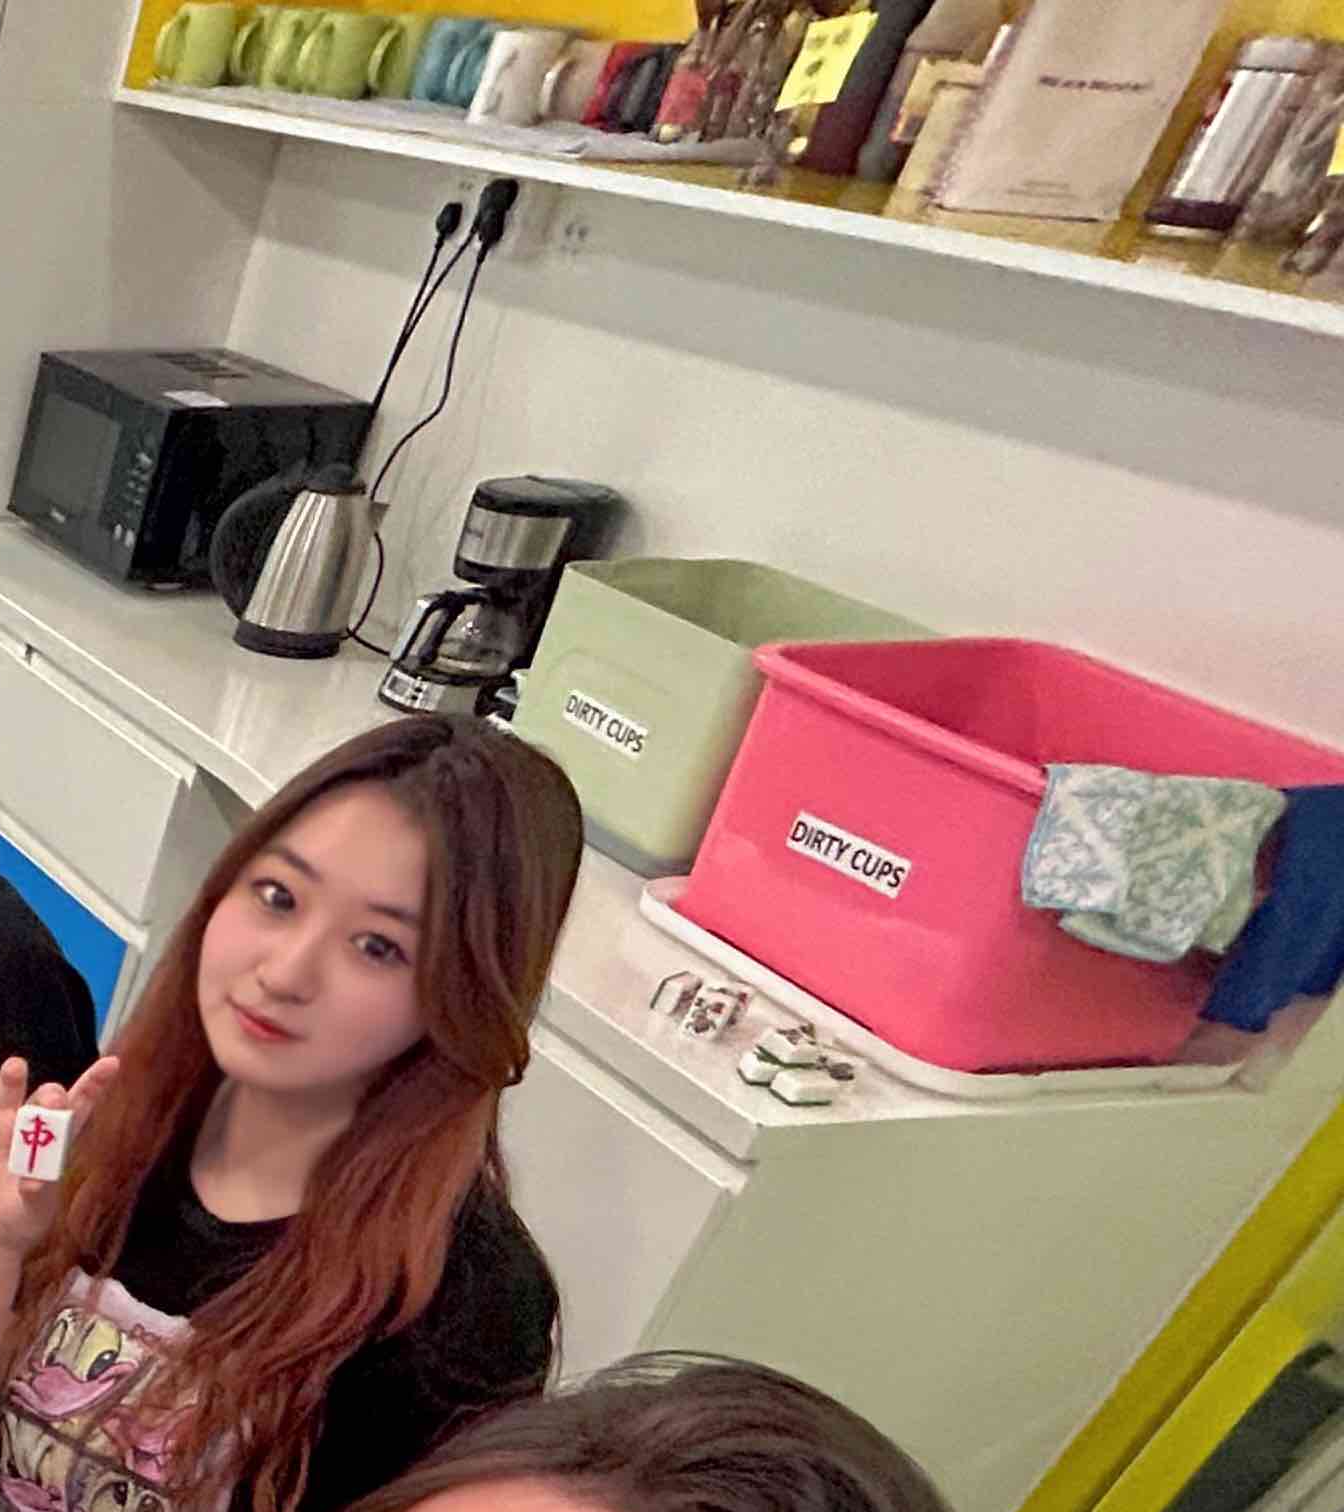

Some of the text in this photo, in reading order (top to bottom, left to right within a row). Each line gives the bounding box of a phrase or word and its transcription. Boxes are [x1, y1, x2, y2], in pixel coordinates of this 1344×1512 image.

[565, 694, 645, 754] DIRTY CUPS
[790, 819, 906, 889] DIRTY CUPS
[19, 1113, 56, 1174] 中
